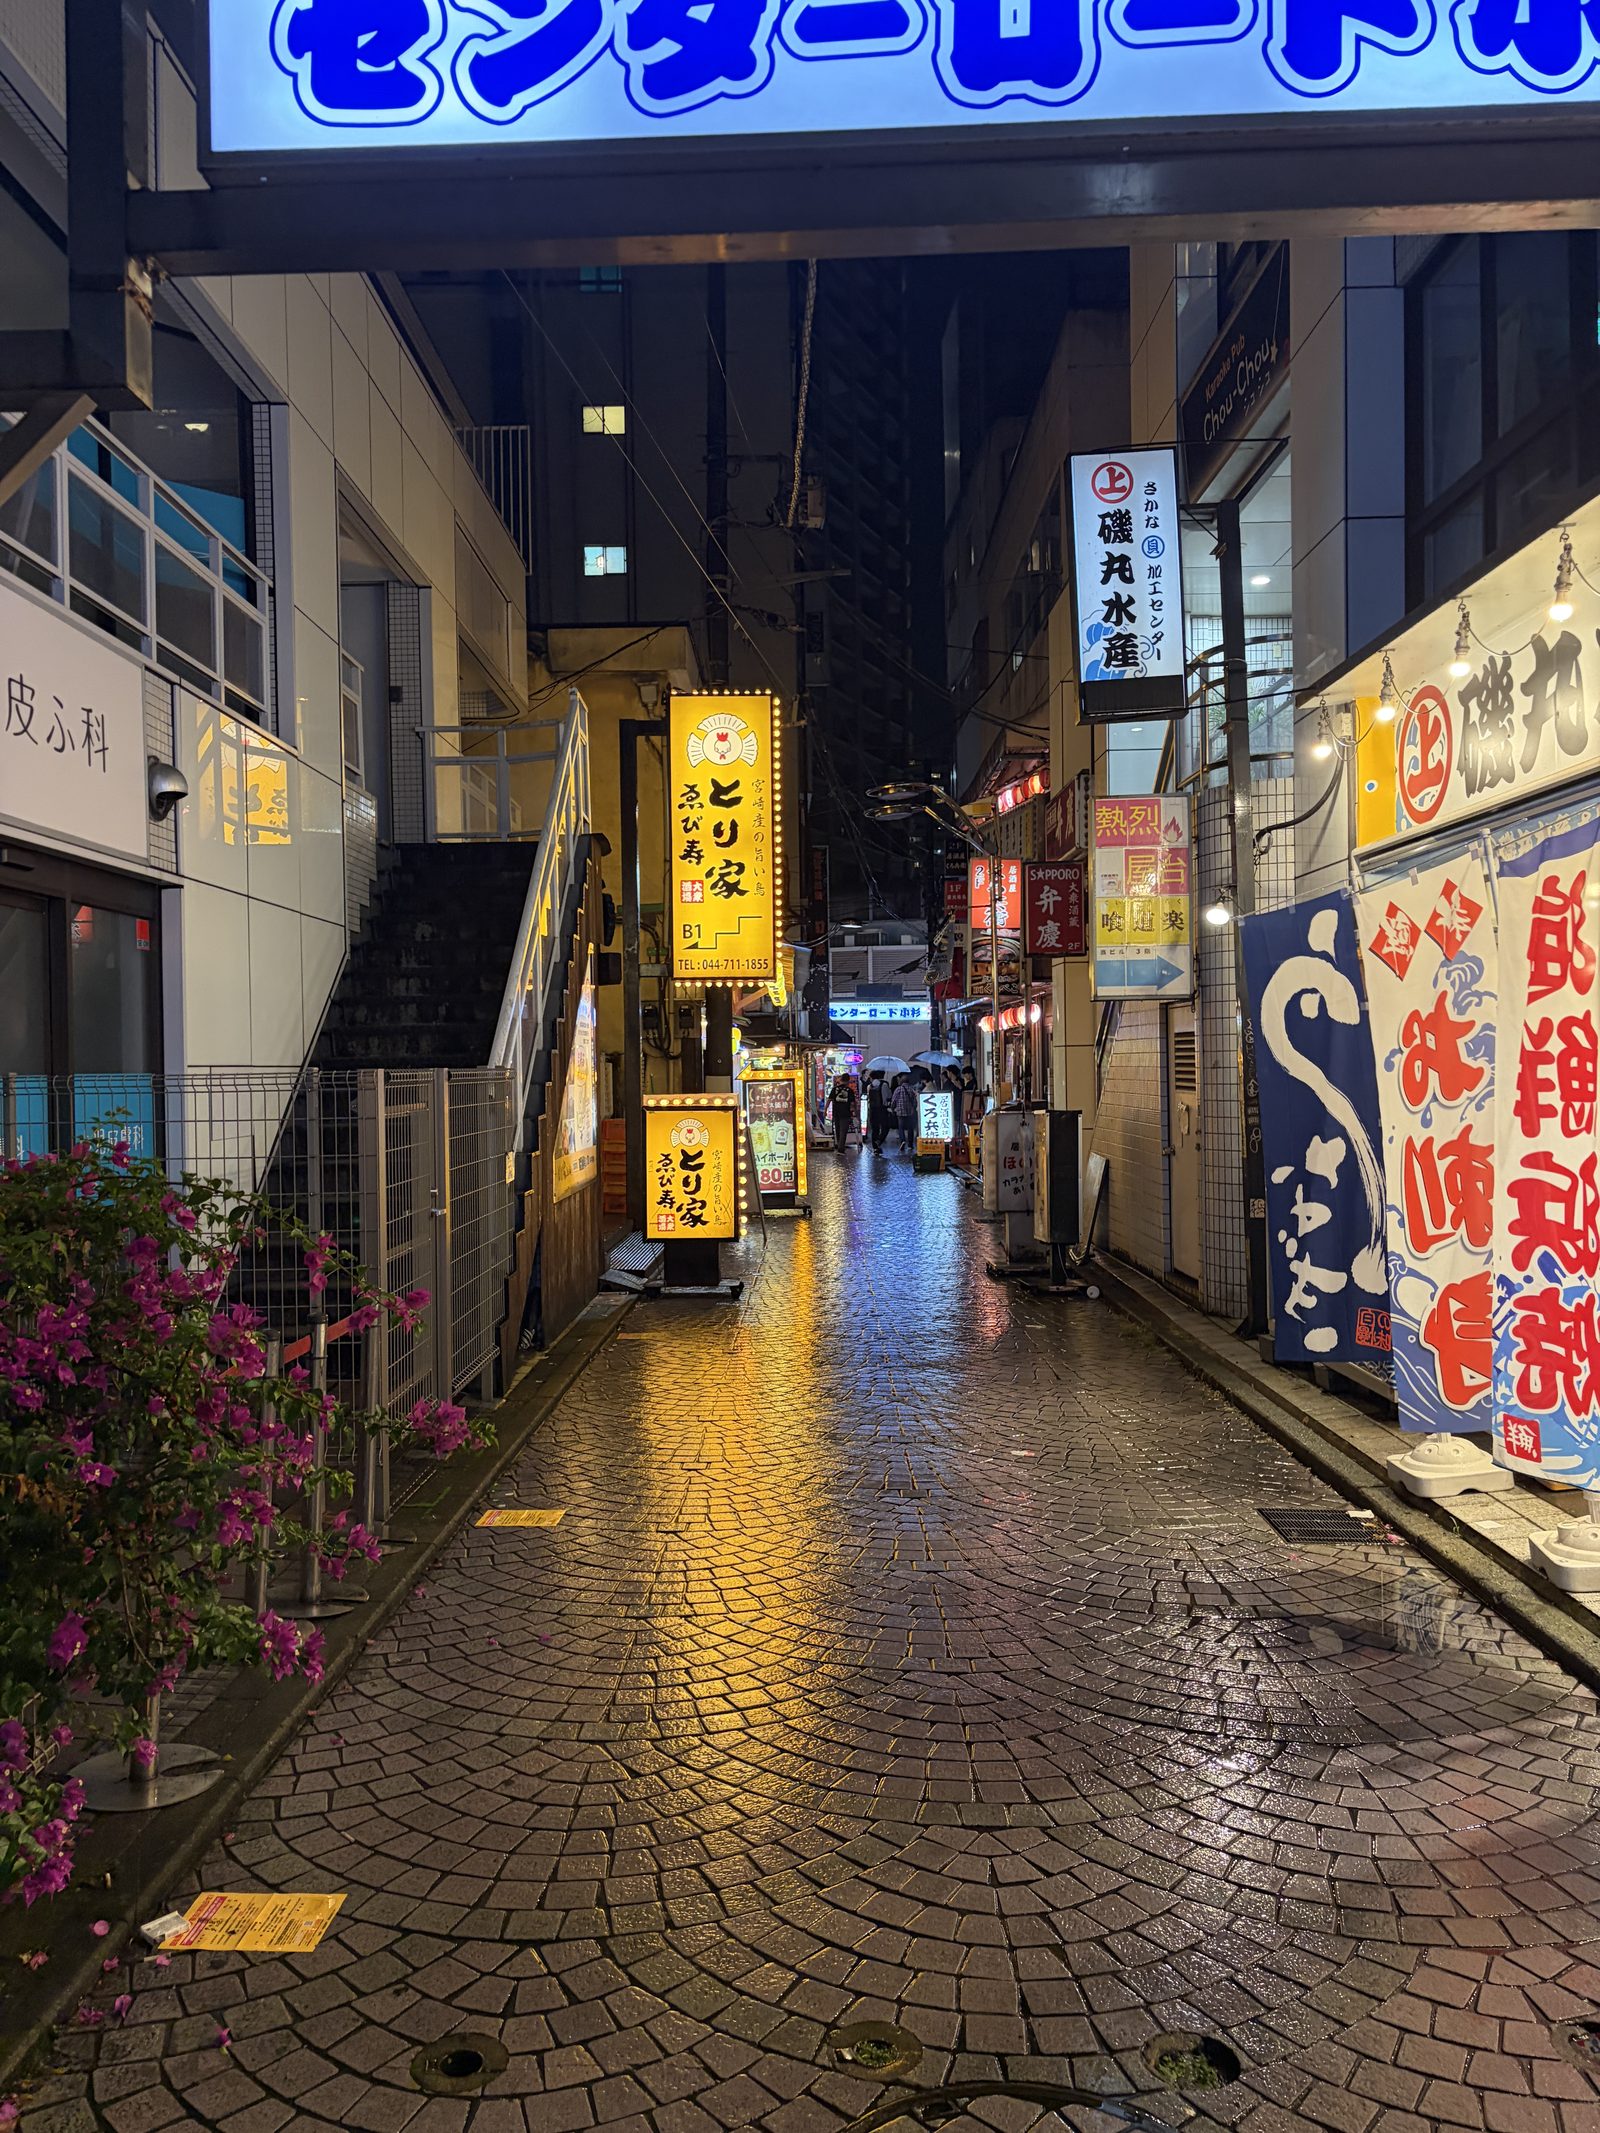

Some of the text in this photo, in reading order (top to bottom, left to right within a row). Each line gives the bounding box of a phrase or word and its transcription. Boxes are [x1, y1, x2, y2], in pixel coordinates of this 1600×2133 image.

[1204, 337, 1269, 445] Chou-Chou
[1205, 357, 1232, 404] Karaoke
[5, 673, 109, 773] 皮ふ科
[678, 783, 705, 866] ゑび寿
[704, 777, 750, 899] とり家
[1095, 805, 1161, 837] 熱烈
[1127, 852, 1187, 888] 屋台
[682, 923, 702, 939] B1
[1035, 885, 1062, 948] 弁慶
[1067, 942, 1081, 950] 2F
[829, 1007, 921, 1018] センターロード小杉
[656, 1153, 676, 1209] ゑび寿
[676, 1149, 709, 1228] とり家
